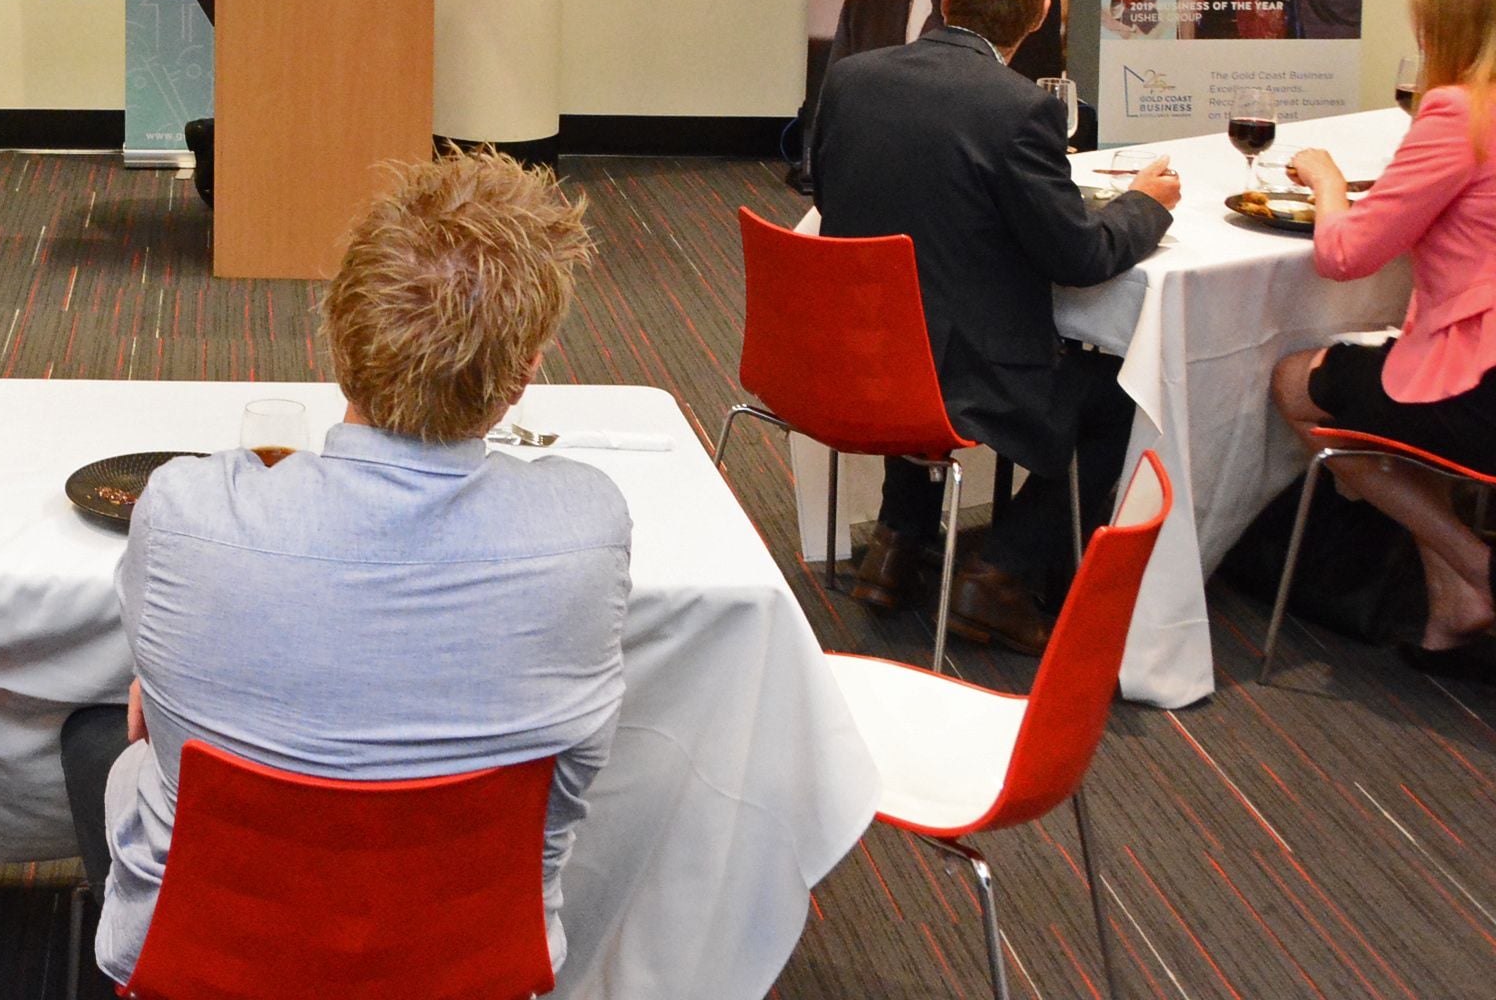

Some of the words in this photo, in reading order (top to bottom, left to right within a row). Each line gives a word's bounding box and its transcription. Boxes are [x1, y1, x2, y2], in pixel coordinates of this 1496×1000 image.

[1130, 2, 1154, 11] 2019
[1213, 1, 1228, 10] OF
[1231, 1, 1253, 10] THE
[1255, 1, 1284, 10] YEAR
[1210, 71, 1229, 80] The
[1231, 71, 1255, 80] Gold
[1258, 71, 1286, 80] Coast
[1289, 71, 1334, 80] Business
[1302, 98, 1346, 106] business
[1139, 104, 1192, 112] BUSINESS
